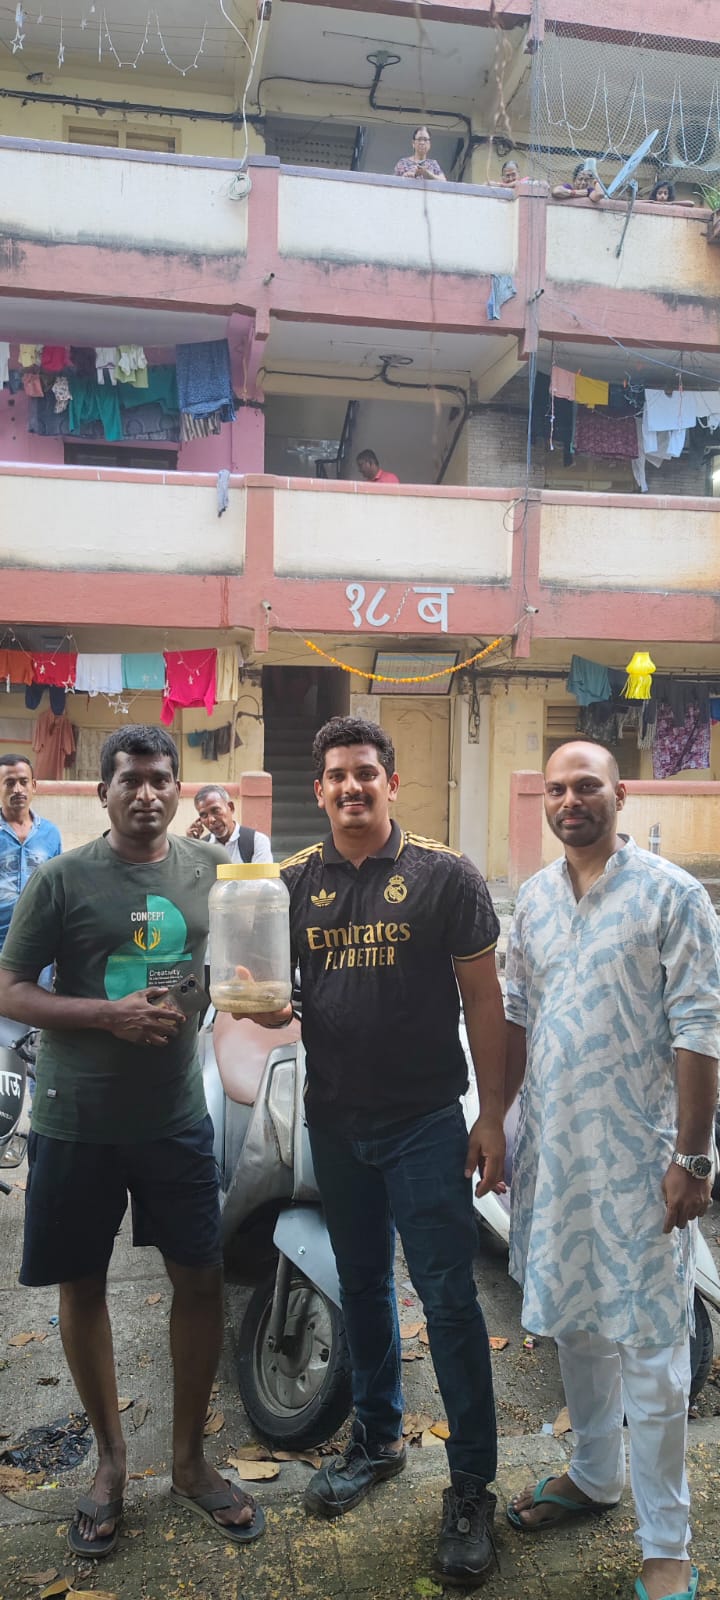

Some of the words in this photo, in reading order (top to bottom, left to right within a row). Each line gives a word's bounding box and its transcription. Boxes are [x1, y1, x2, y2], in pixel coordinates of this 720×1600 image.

[130, 911, 165, 922] CONCEPT
[306, 920, 411, 950] Emirates
[149, 969, 181, 977] Creativity
[0, 1070, 22, 1100] ाऊ
